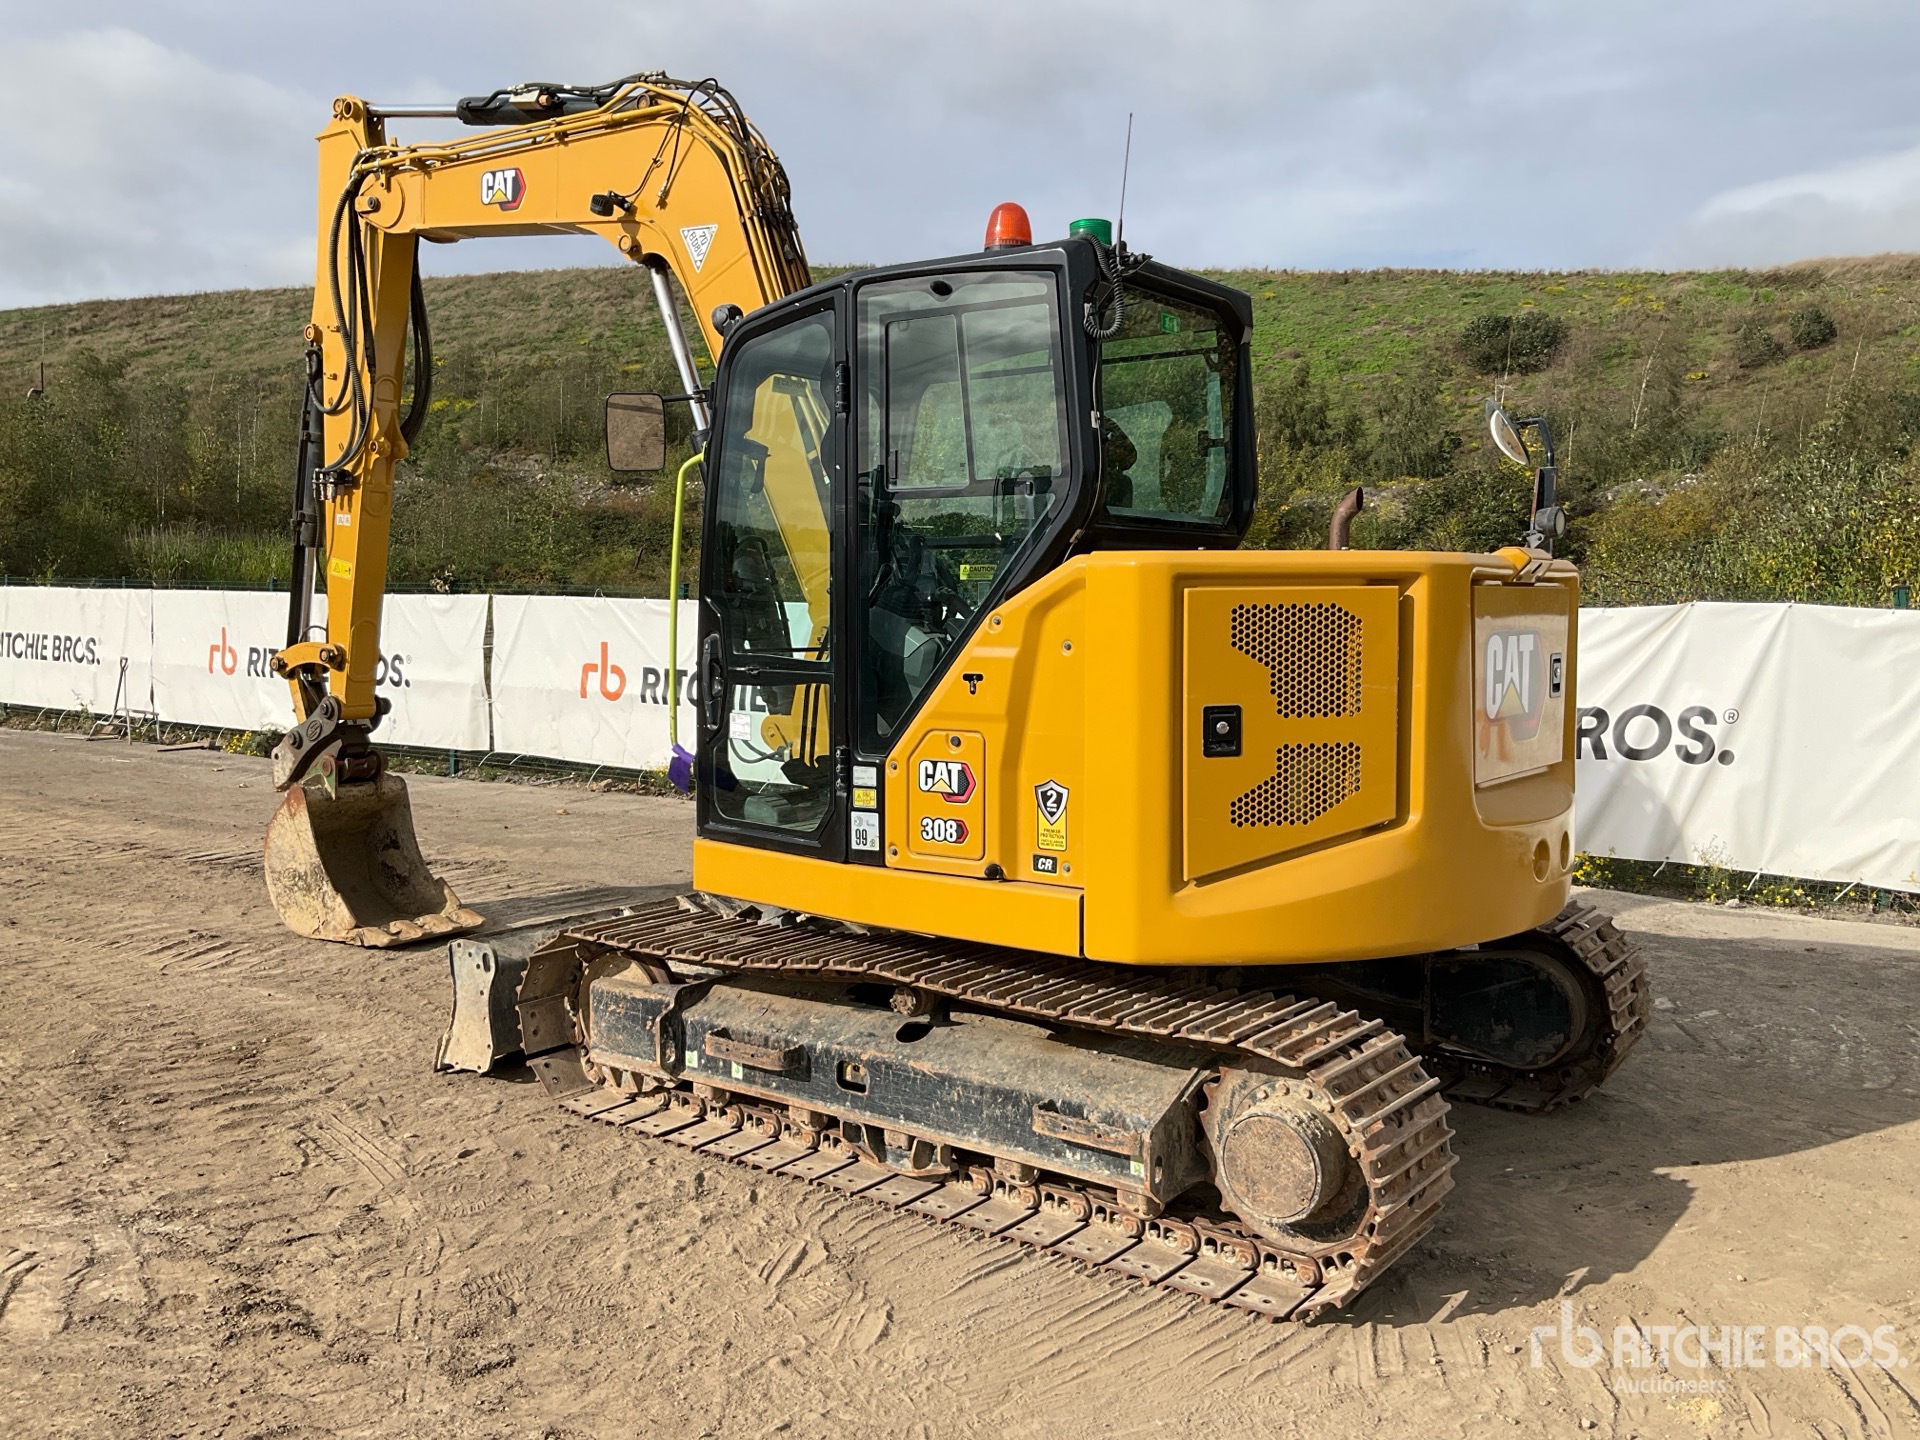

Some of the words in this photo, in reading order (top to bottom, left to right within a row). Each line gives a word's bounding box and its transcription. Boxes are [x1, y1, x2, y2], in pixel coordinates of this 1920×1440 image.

[482, 170, 516, 205] CAT
[0, 631, 48, 661] ITCHIE
[580, 642, 627, 701] rb
[1486, 634, 1534, 719] CAT
[1576, 704, 1735, 766] ROS.
[919, 760, 962, 794] CAT
[1046, 789, 1057, 807] 2
[855, 828, 868, 847] 99
[921, 818, 957, 843] 308
[1037, 857, 1053, 871] CR
